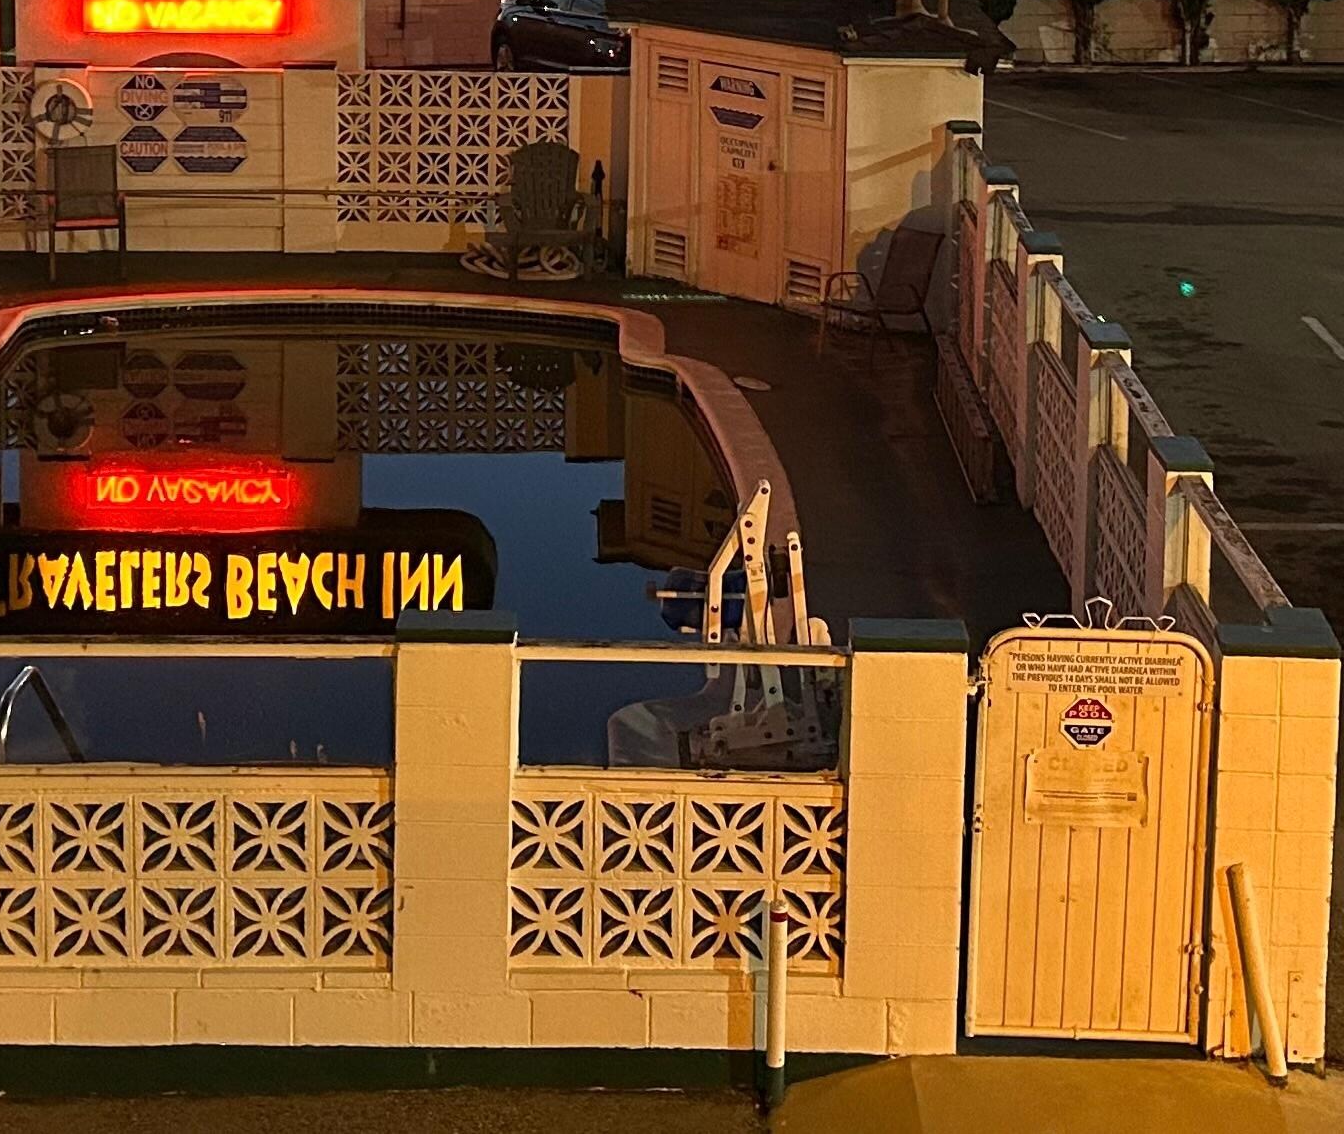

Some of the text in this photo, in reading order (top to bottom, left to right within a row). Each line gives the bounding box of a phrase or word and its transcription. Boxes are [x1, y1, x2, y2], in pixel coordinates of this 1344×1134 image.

[136, 75, 155, 89] NO
[120, 90, 168, 104] DIVING
[120, 142, 168, 155] CAUTION
[1047, 653, 1075, 663] HAVING
[1076, 654, 1117, 664] CURRENTLY
[1118, 656, 1143, 665] ACTIVE
[1016, 662, 1177, 676] OR WHO HAVE HAD ACTIVE DIARRHEA WITHIN
[1012, 672, 1180, 686] THE PREVIOUS 14 DAYS SHALL NOT BE ALLOWED
[1048, 683, 1143, 694] TO ENTER THE POOL WATER
[1069, 710, 1109, 718] POOL
[1078, 704, 1101, 712] KEEP
[1070, 726, 1105, 734] GATE
